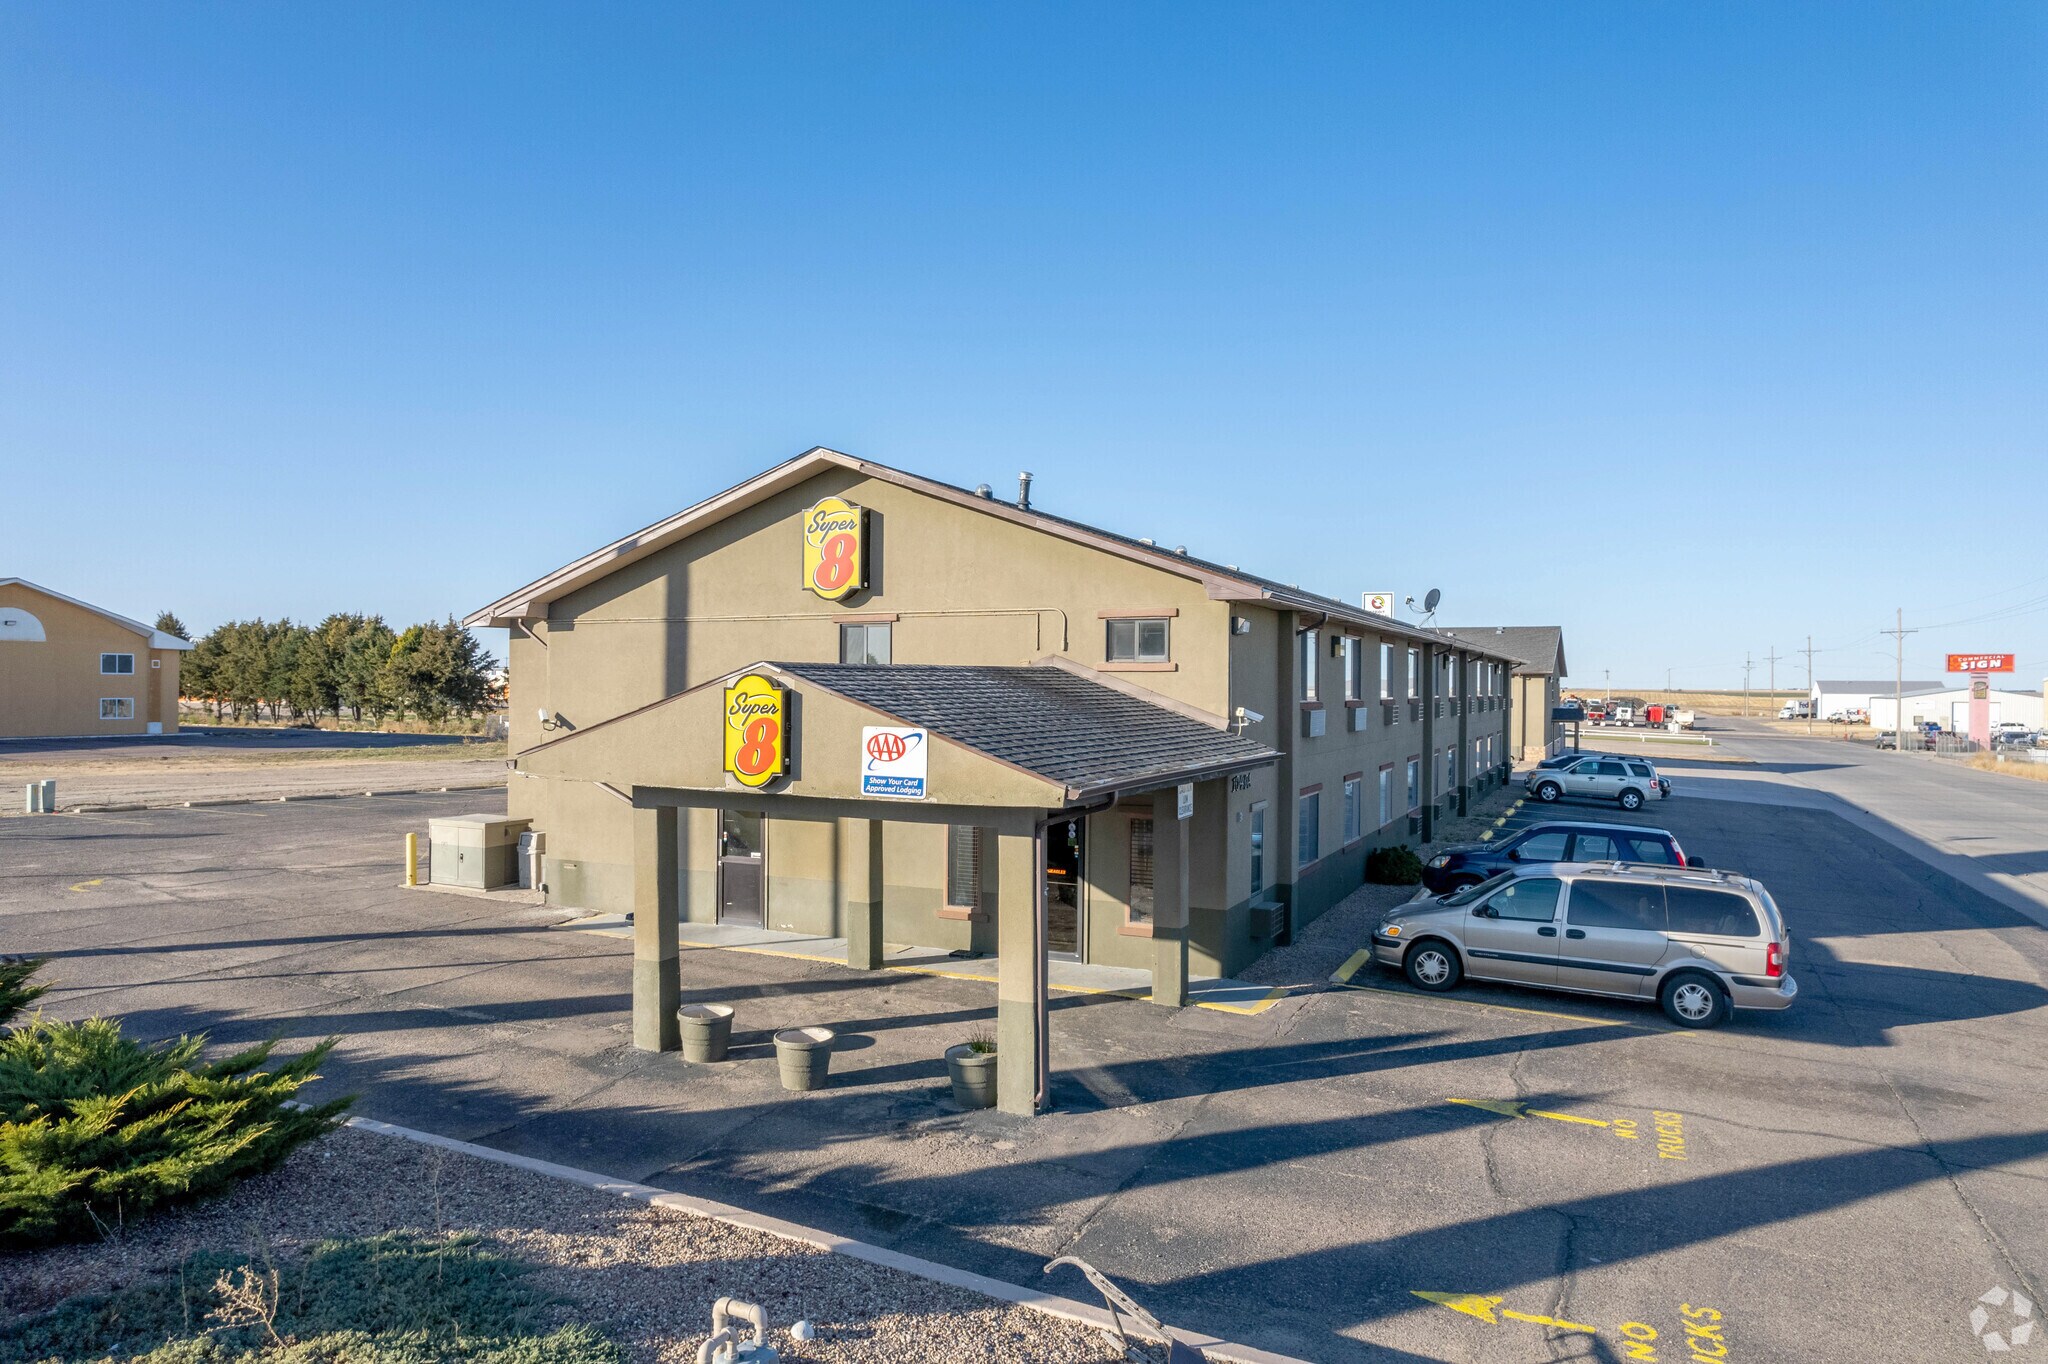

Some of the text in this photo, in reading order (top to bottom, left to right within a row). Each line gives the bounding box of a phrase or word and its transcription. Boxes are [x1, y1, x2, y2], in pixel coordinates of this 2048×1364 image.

[807, 510, 857, 544] Super
[813, 533, 857, 591] 8
[1961, 660, 2002, 670] SIGN
[729, 692, 779, 727] Super
[735, 717, 779, 776] 8
[871, 733, 902, 761] AAA
[896, 786, 922, 795] Lodging
[1612, 1119, 1639, 1140] NO
[1652, 1110, 1689, 1161] TRUCKS
[1620, 1321, 1659, 1363] NO
[1680, 1302, 1728, 1364] CKS
